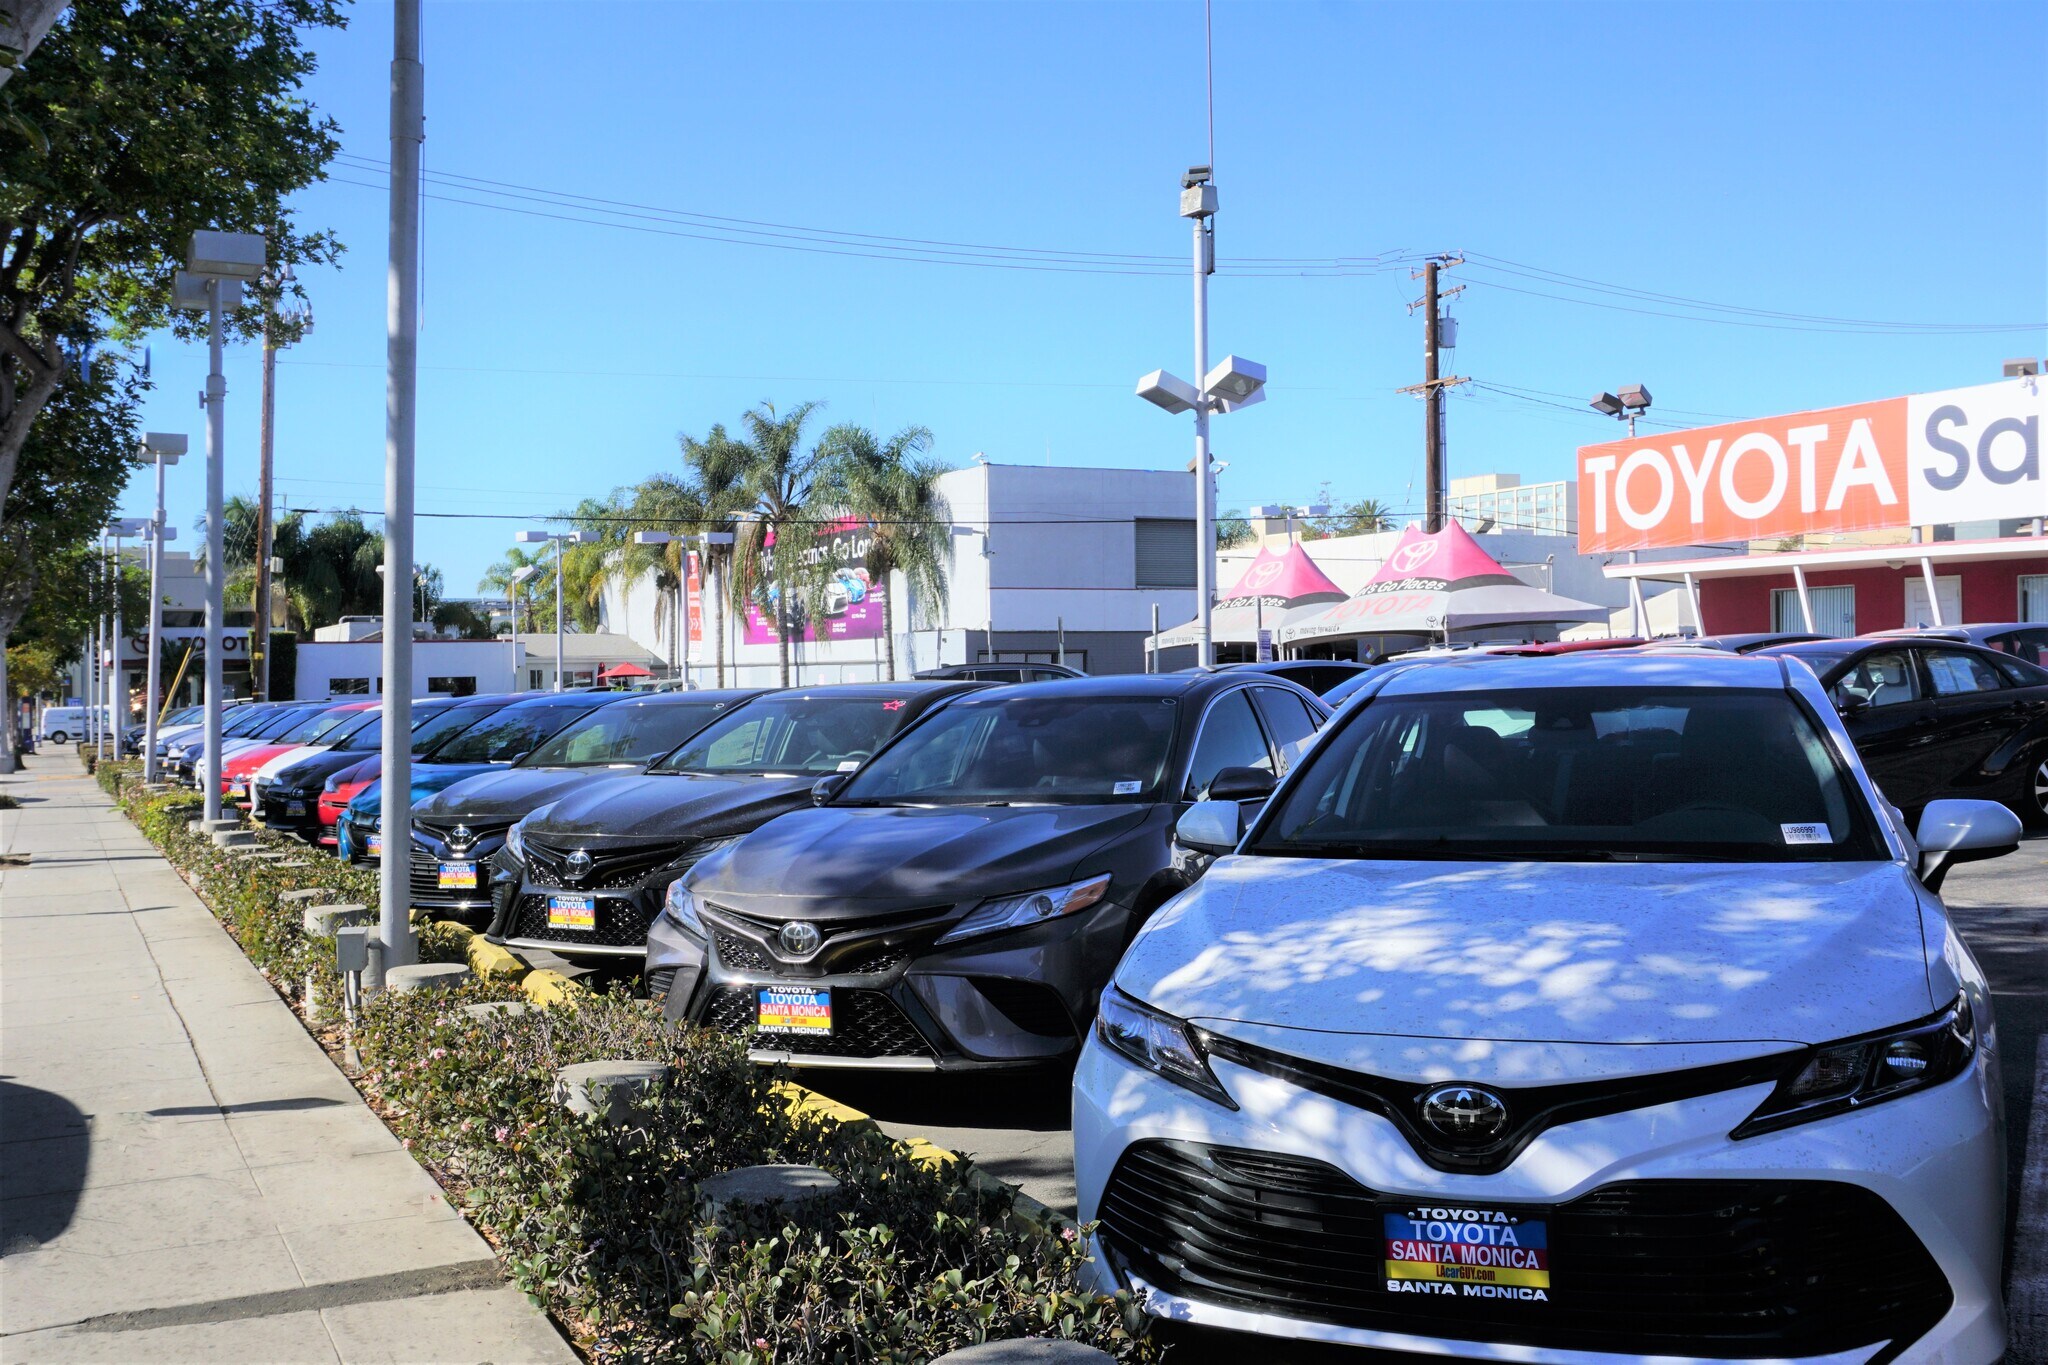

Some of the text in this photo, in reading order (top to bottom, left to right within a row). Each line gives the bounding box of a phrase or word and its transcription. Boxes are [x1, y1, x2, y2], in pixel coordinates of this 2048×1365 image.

[1585, 404, 2039, 533] TOYOTA Sa
[1378, 581, 1398, 592] Go
[1397, 577, 1447, 591] Places
[1230, 597, 1247, 608] Go
[1322, 595, 1435, 621] TOYOTA
[556, 901, 587, 909] TOYOTA
[771, 986, 813, 994] TOYOTA
[768, 993, 817, 1005] TOYOTA
[761, 1004, 827, 1017] SANTA MONICA
[757, 1025, 830, 1035] SANTA MONICA
[1417, 1207, 1508, 1223] TOYOTA
[1410, 1220, 1518, 1247] TOYOTA
[1392, 1240, 1539, 1269] SANTA MONICA
[1436, 1265, 1495, 1281] LAcarGUY.com
[1386, 1280, 1549, 1301] SANTA MONICA
